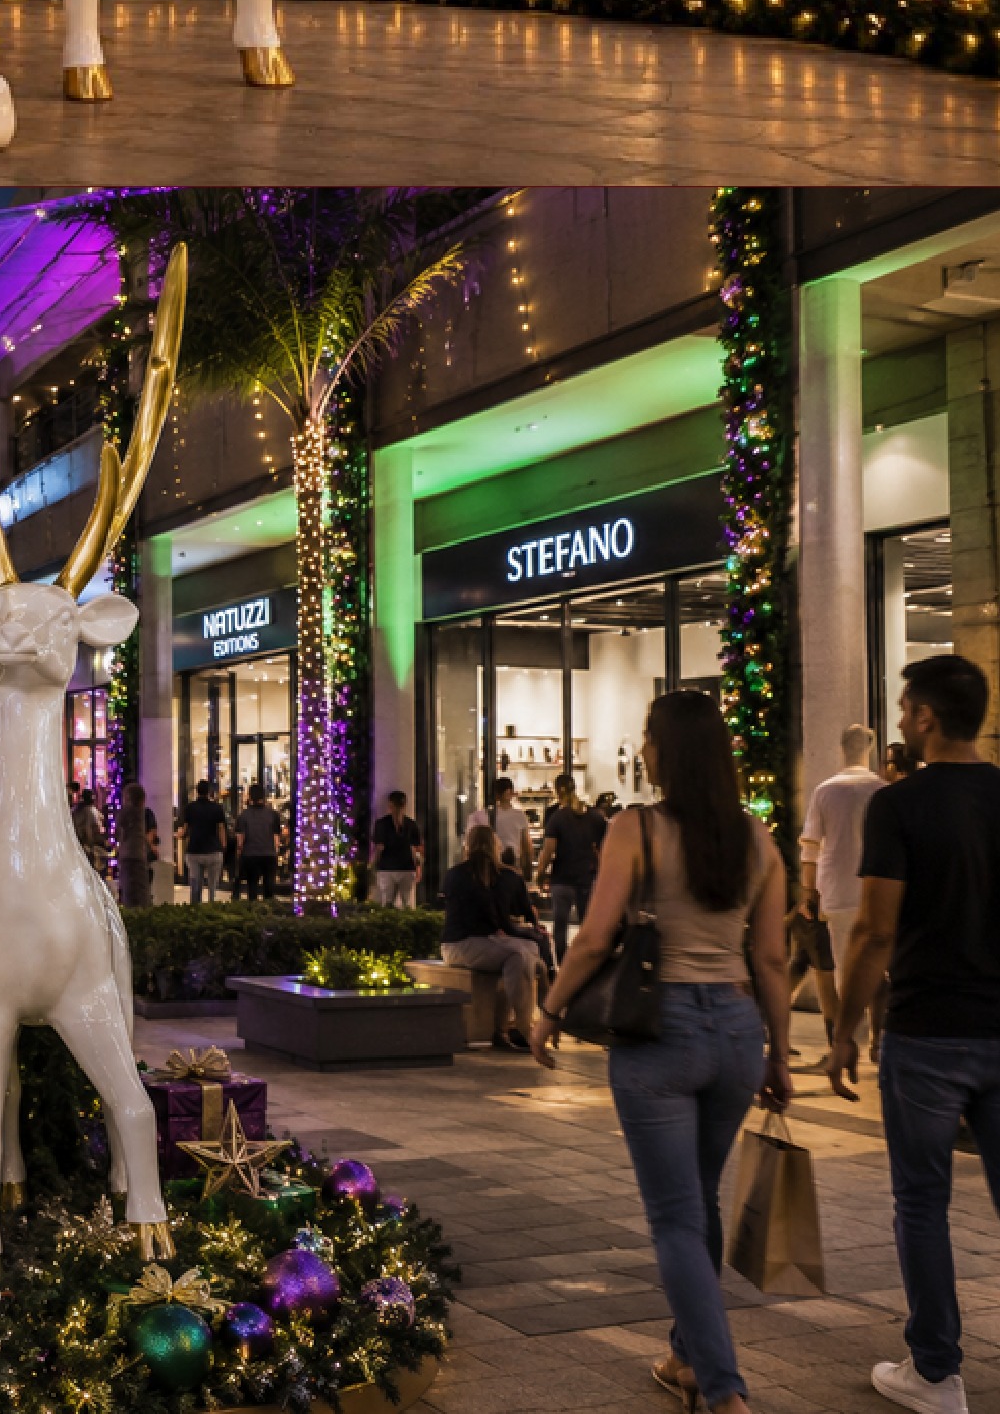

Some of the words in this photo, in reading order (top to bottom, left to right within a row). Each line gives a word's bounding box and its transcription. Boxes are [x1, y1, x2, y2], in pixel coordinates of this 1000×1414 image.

[506, 518, 634, 582] STEFANO
[203, 596, 270, 639] NATUZZI
[213, 632, 259, 657] EDITIONS
